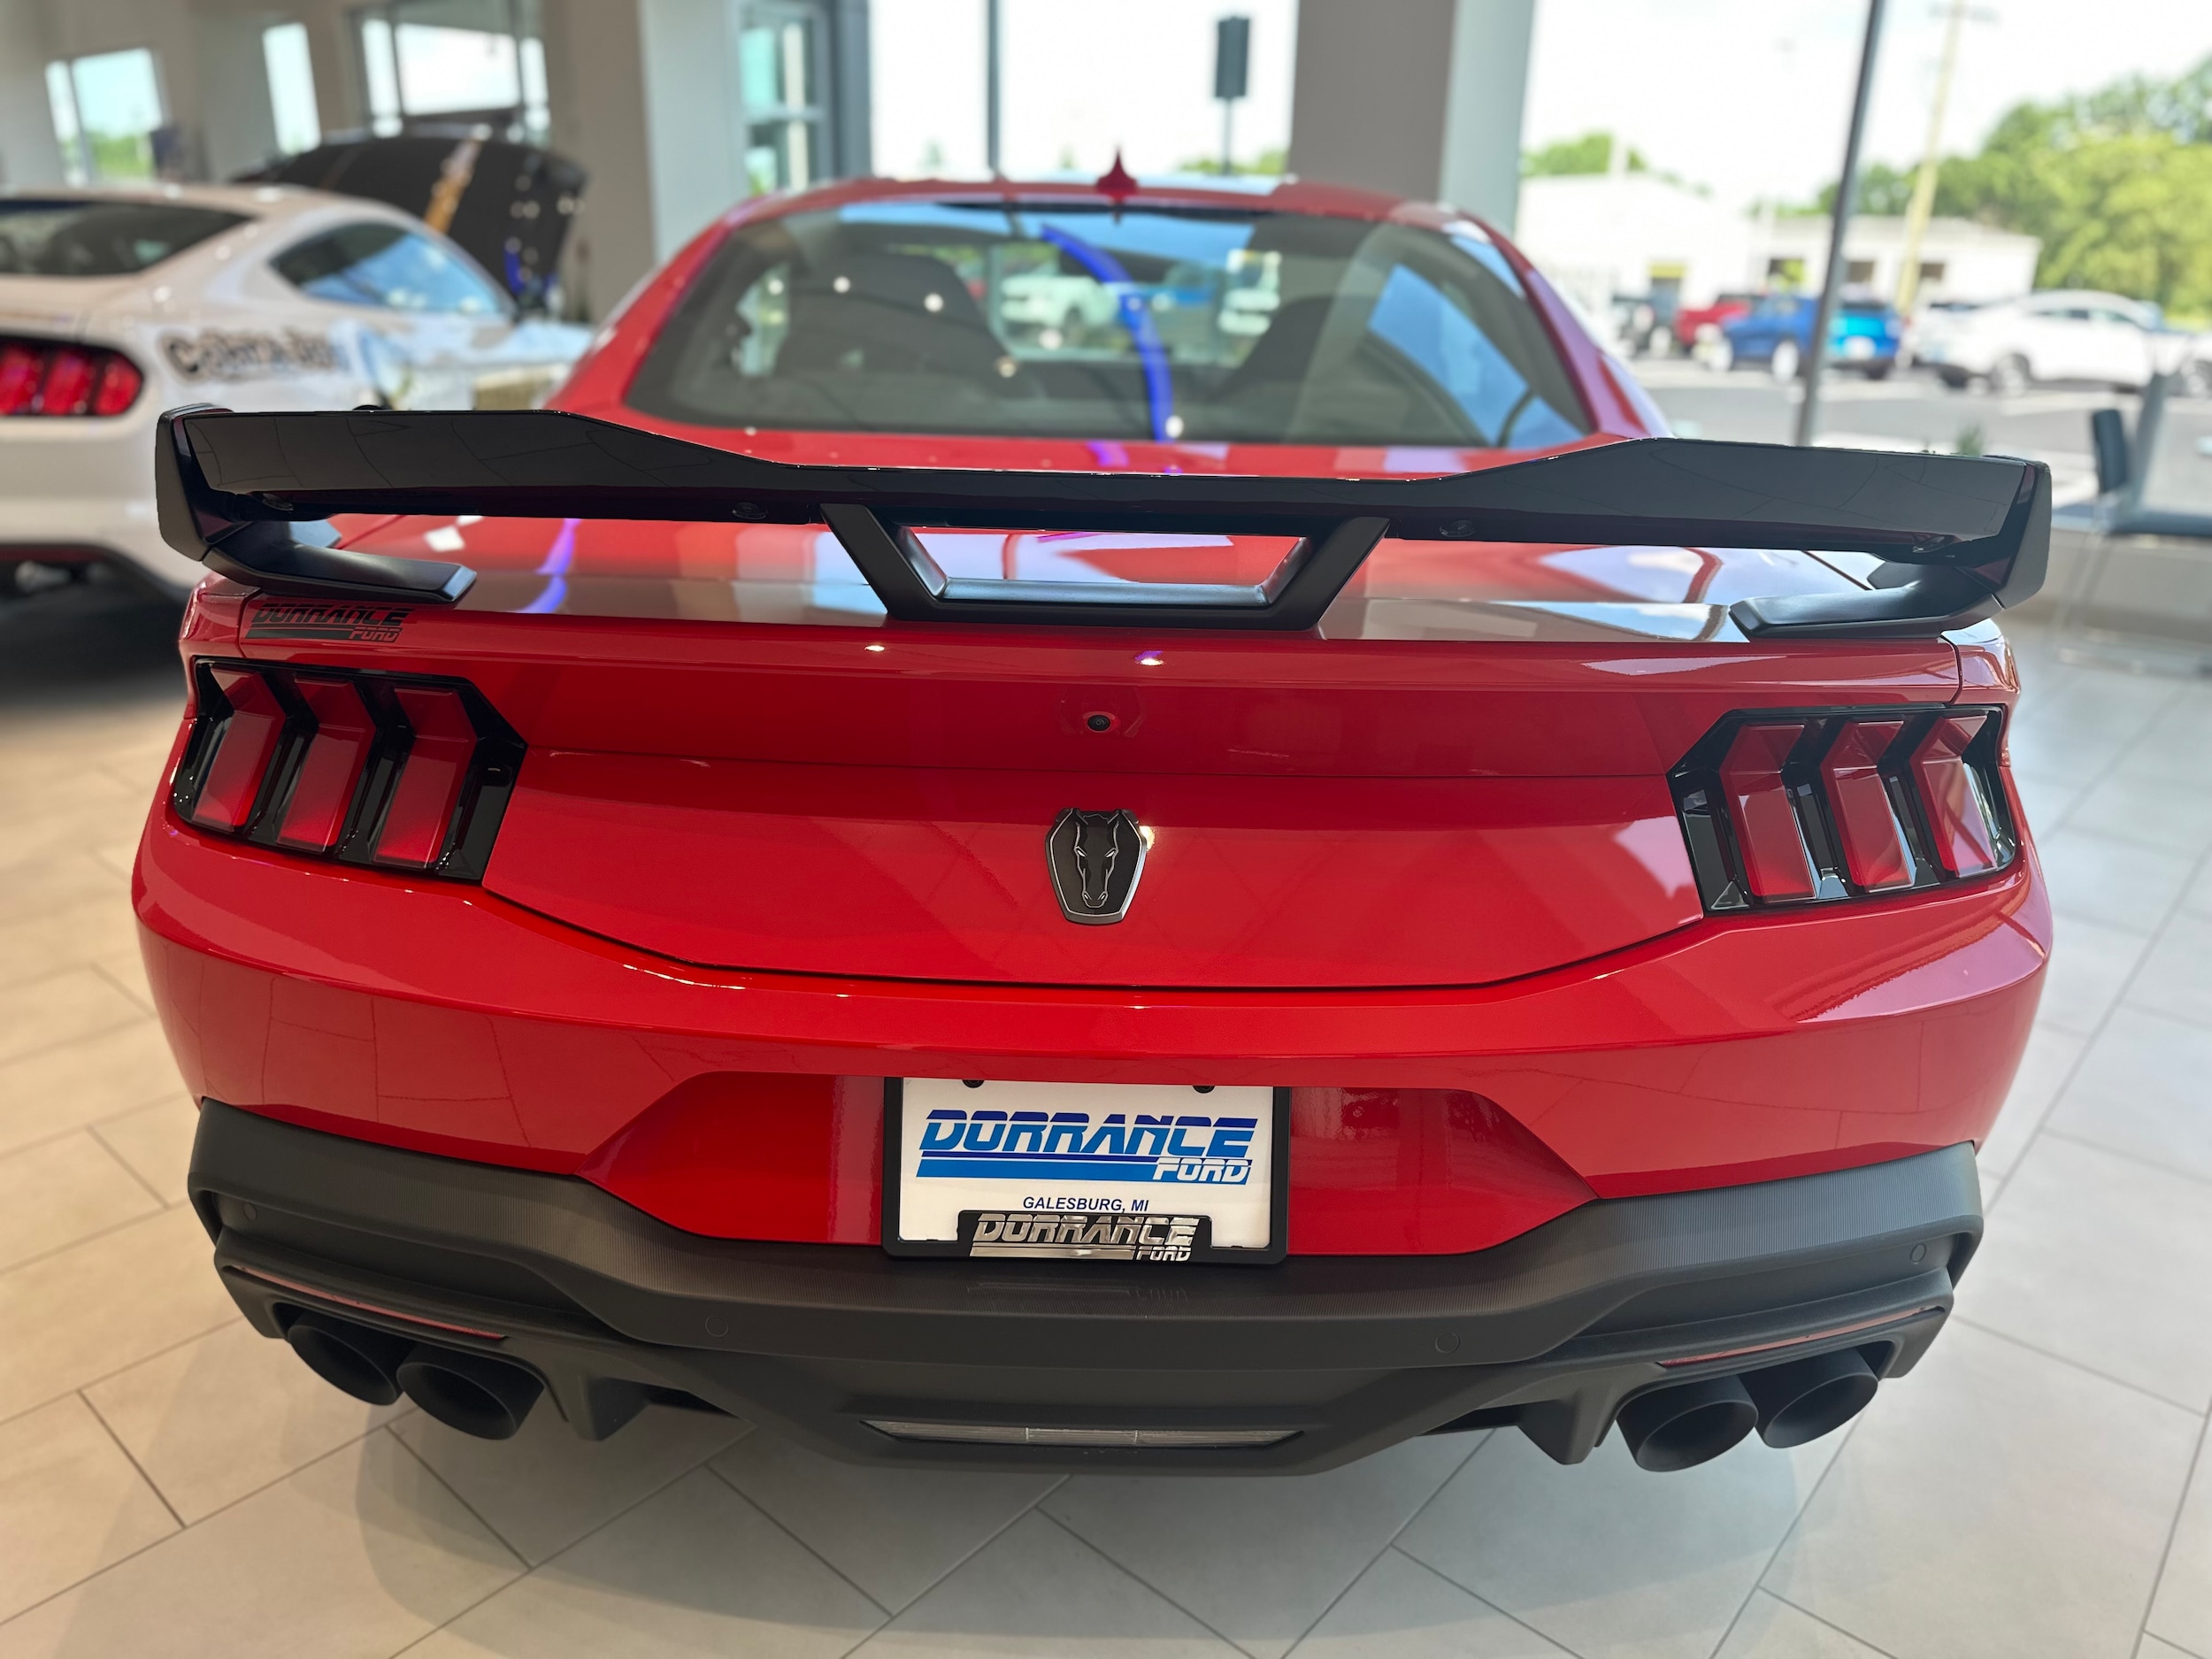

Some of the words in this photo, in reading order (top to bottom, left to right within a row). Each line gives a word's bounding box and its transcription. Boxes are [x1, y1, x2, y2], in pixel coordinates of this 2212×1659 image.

[251, 603, 414, 626] DORRANCE
[349, 626, 402, 642] FORD
[919, 1110, 1257, 1157] DORRANCE
[1153, 1158, 1251, 1182] FORD
[1023, 1196, 1125, 1213] GALESBURG,
[1131, 1200, 1149, 1211] MI
[973, 1213, 1199, 1246] DORRANCE
[1136, 1246, 1191, 1262] FORD
